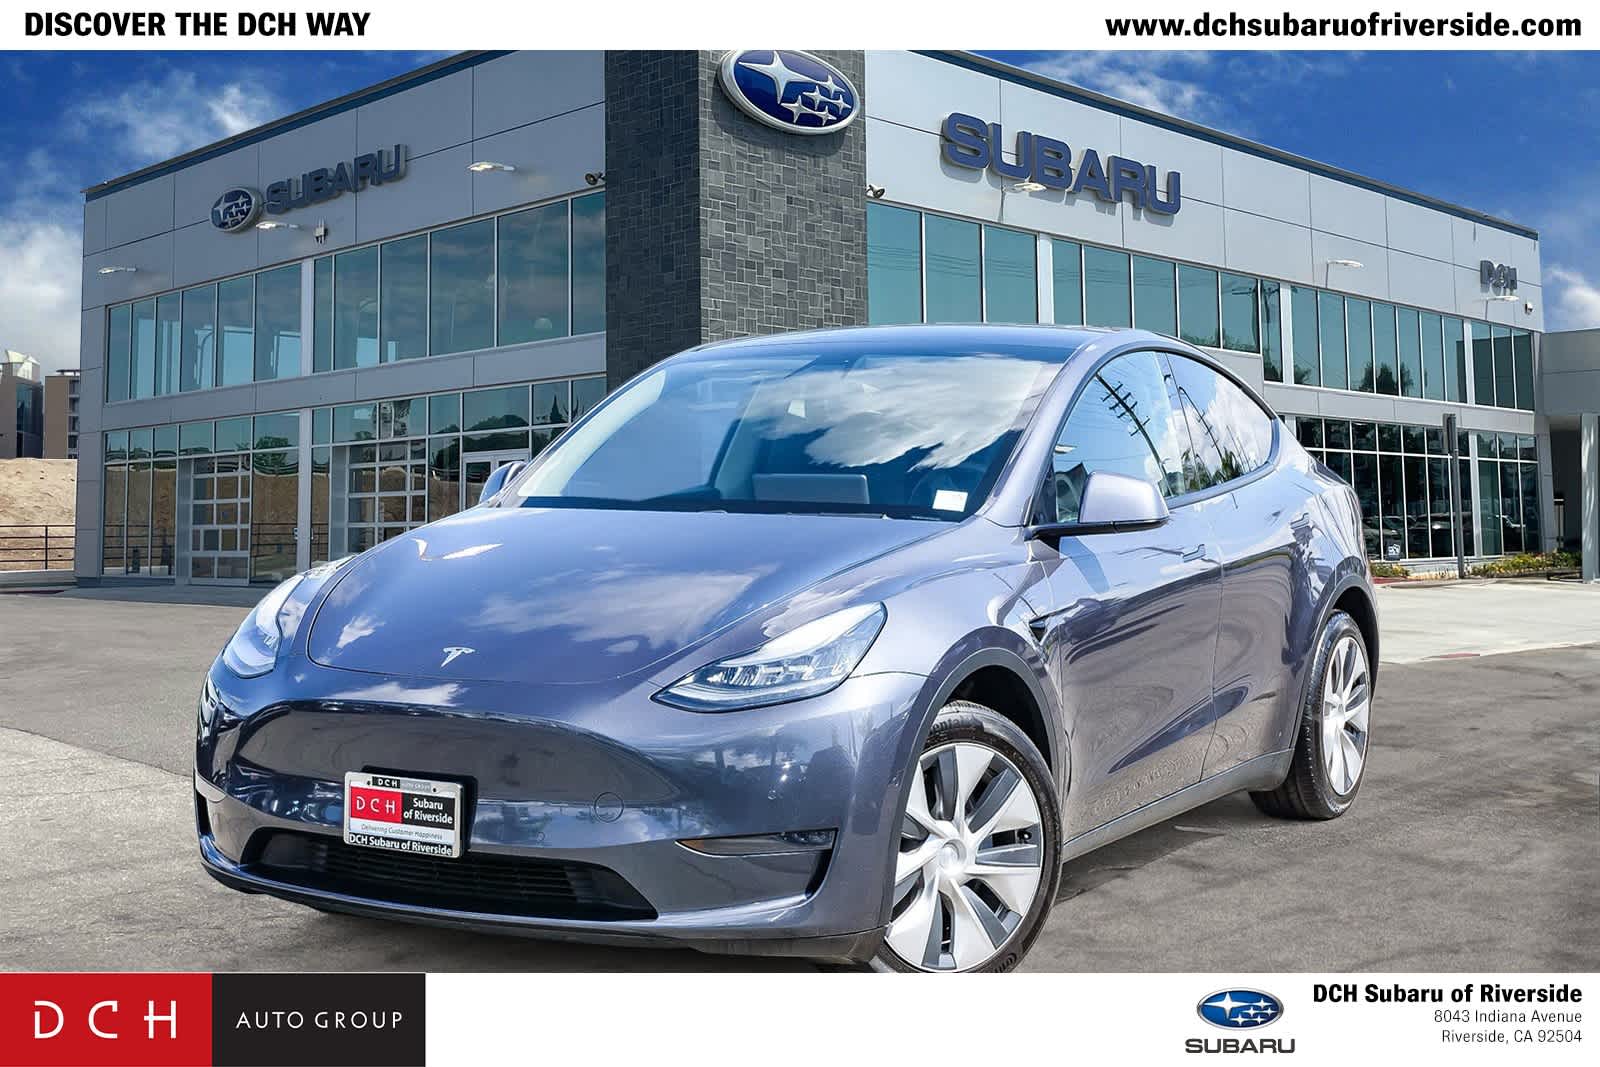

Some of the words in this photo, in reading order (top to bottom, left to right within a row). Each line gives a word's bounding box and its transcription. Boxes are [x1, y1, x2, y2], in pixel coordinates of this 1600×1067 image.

[942, 112, 1182, 216] SUBARU
[265, 144, 406, 215] SUBARU
[377, 778, 398, 788] DCH
[356, 796, 396, 815] DCH
[413, 797, 443, 810] Subaru
[403, 808, 414, 819] of
[414, 811, 453, 825] Riverside
[349, 833, 368, 845] DCH
[369, 836, 400, 850] Subaru
[401, 840, 411, 850] of
[411, 842, 452, 856] Riverside
